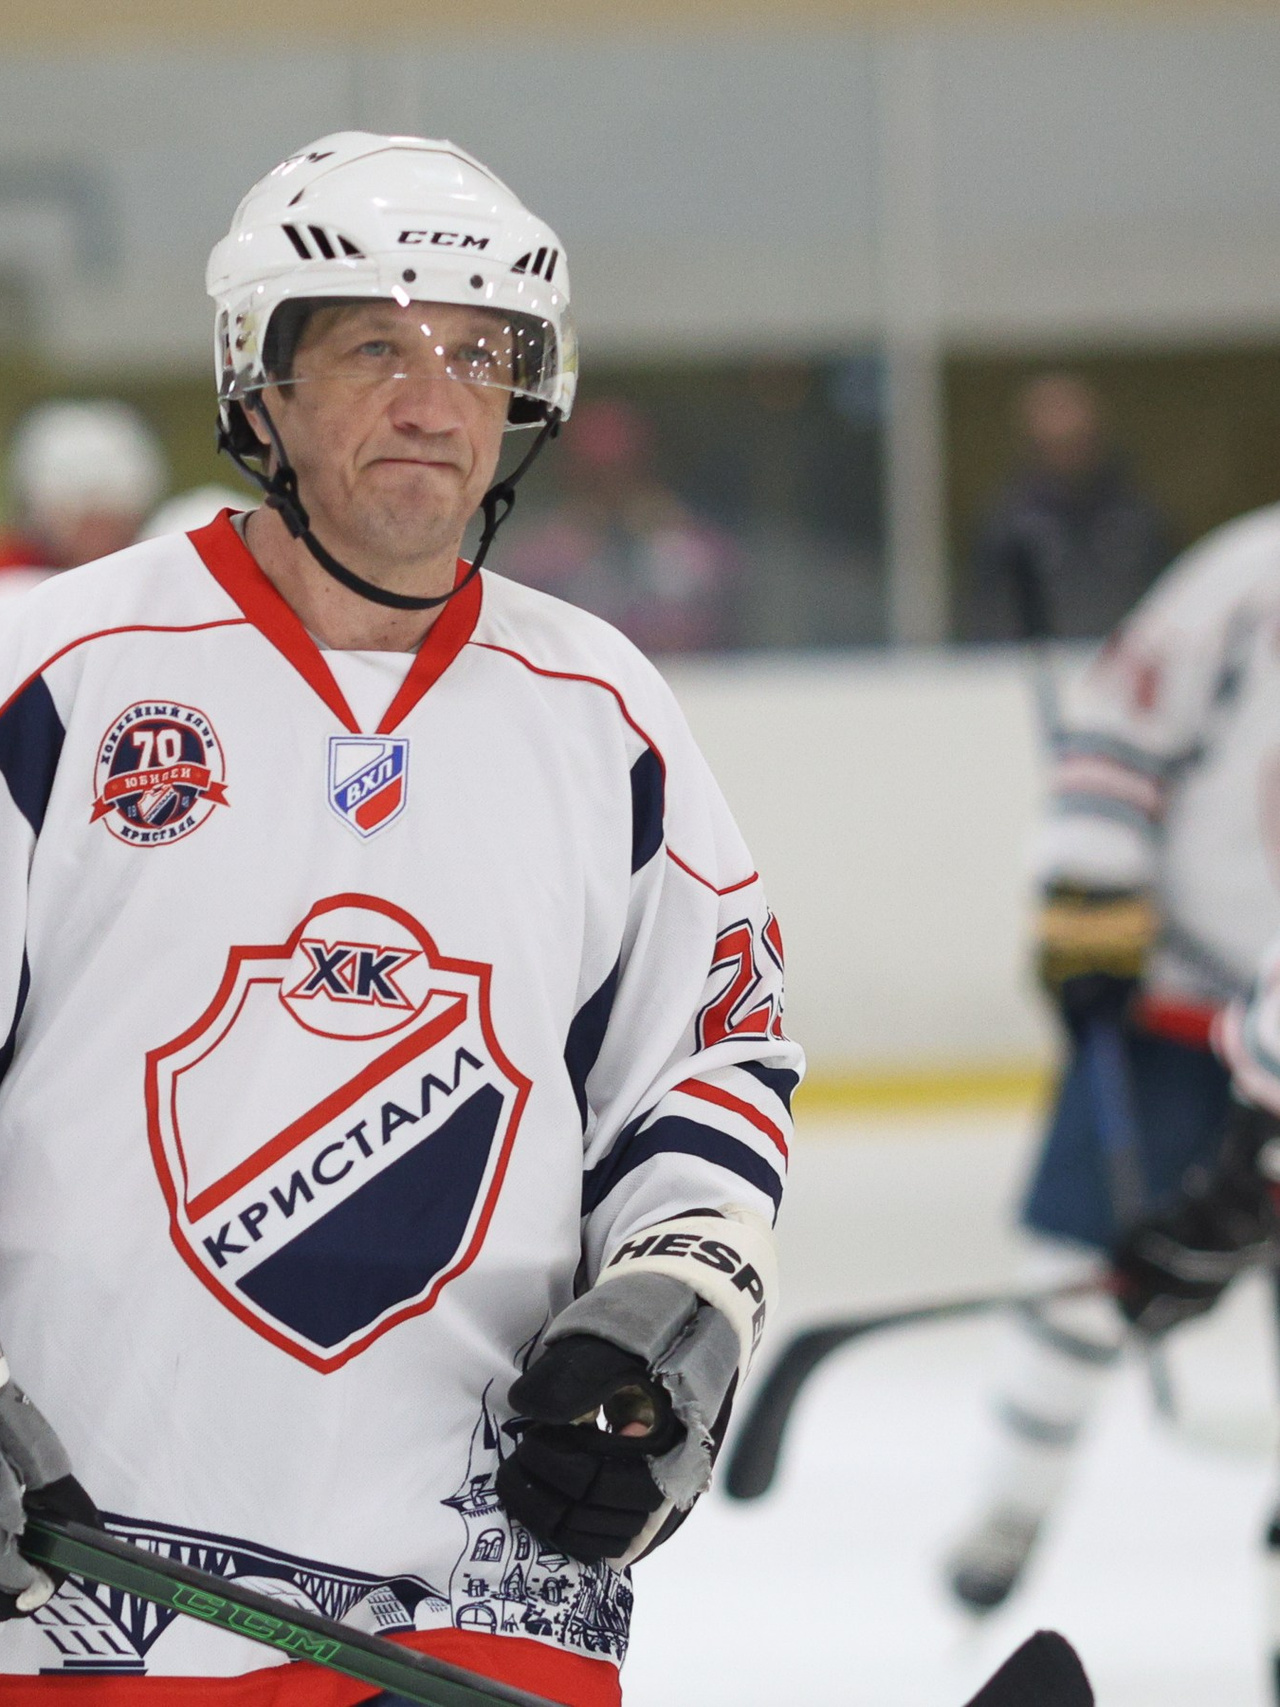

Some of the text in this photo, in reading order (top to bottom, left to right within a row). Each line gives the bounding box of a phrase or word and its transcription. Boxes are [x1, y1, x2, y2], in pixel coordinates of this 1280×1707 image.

[397, 230, 491, 251] CCM
[132, 728, 183, 772] 70
[346, 757, 394, 808] ВХЛ
[120, 815, 196, 843] КРИСТАЛЛ
[295, 942, 414, 1006] ХК
[202, 1046, 485, 1269] КРИСТАЛЛ
[172, 1582, 342, 1663] CCM
